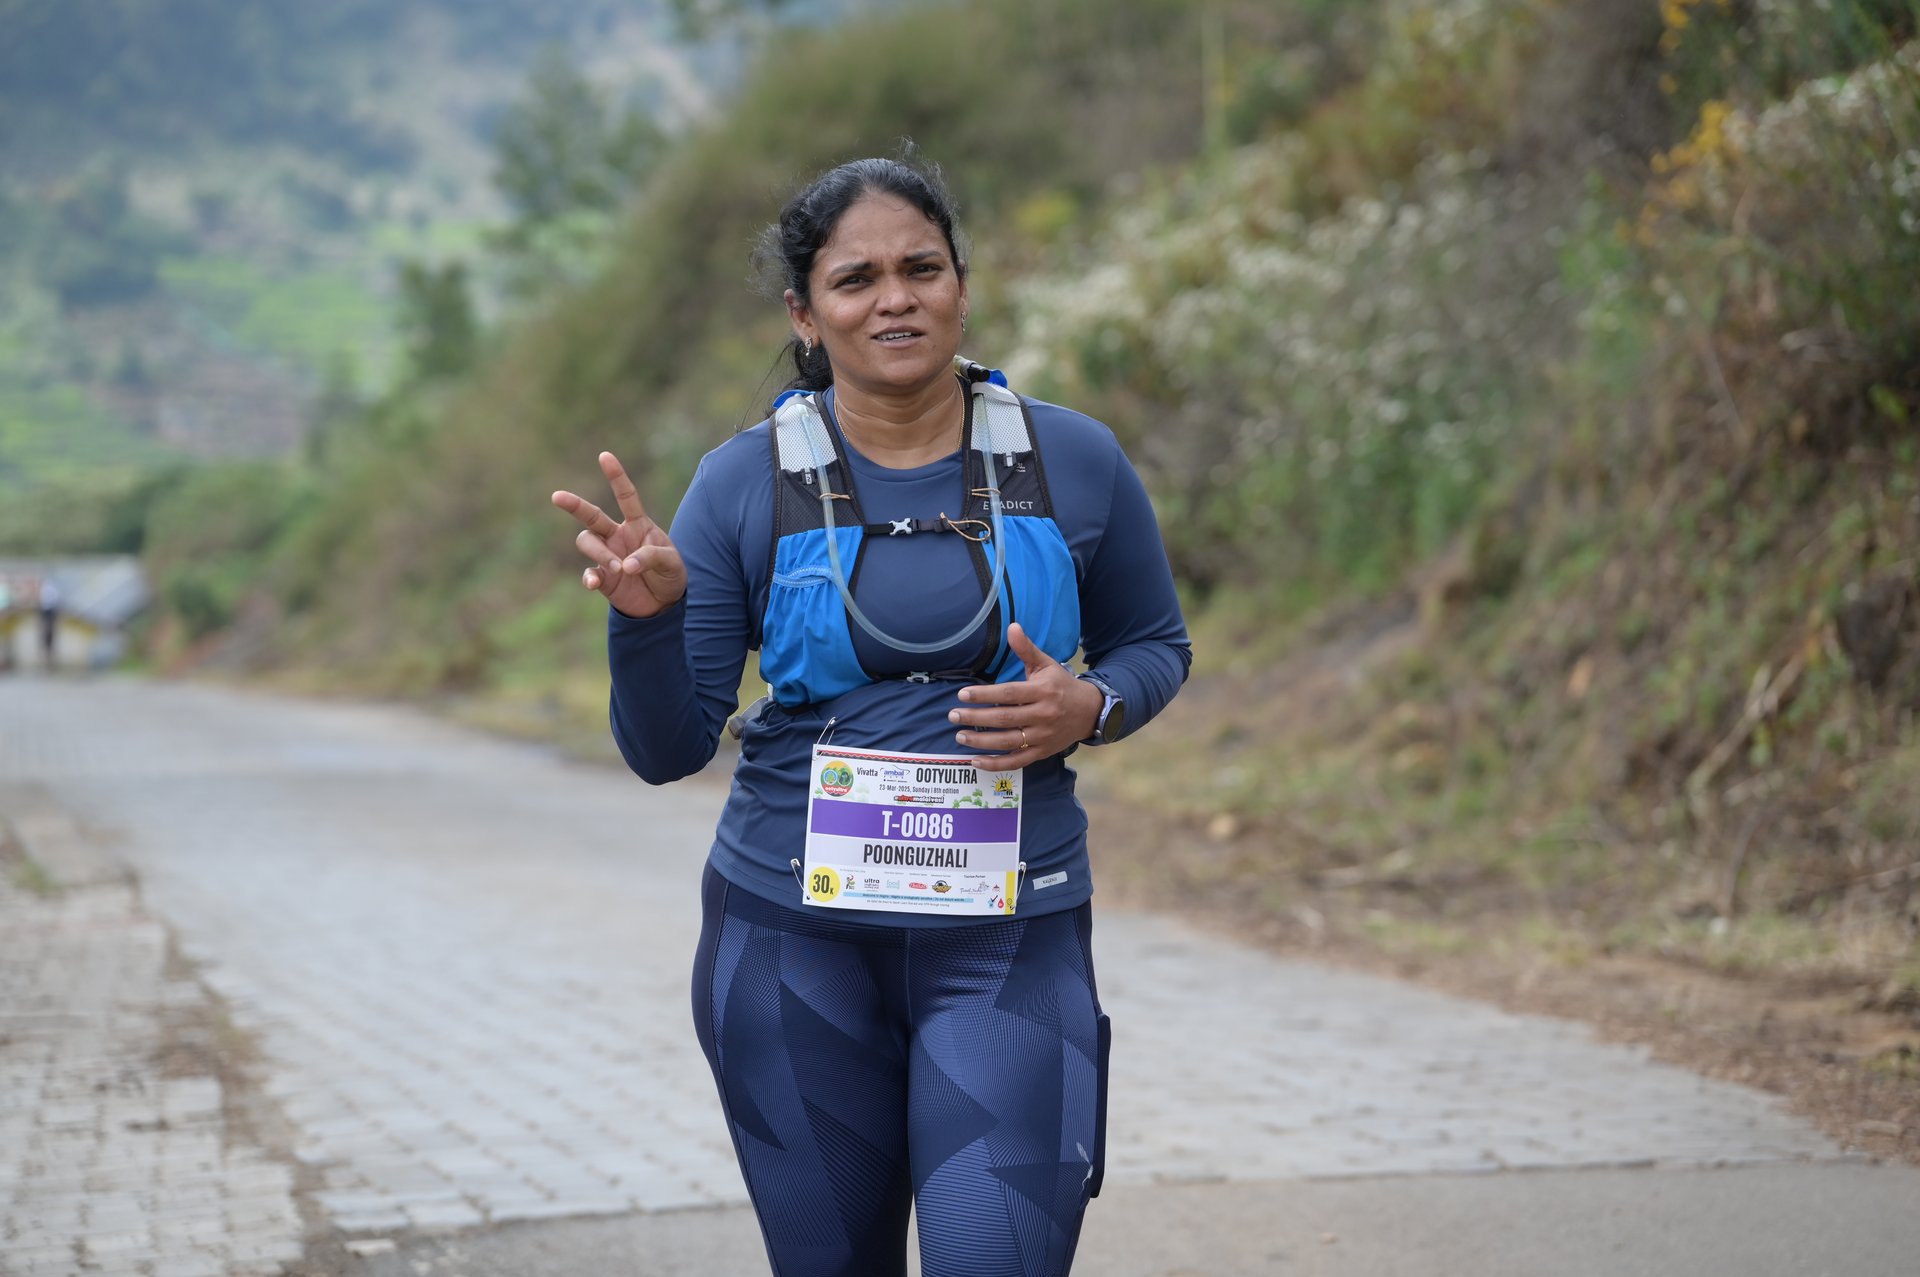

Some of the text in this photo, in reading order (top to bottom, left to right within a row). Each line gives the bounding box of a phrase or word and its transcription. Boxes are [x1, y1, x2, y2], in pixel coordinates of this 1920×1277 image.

[983, 500, 1034, 511] EADICT
[856, 767, 879, 777] Vivatta
[916, 768, 978, 784] OOTYULTRA
[912, 786, 930, 794] Sunday
[882, 810, 954, 840] T-0086
[863, 844, 968, 869] POONGUZHALI
